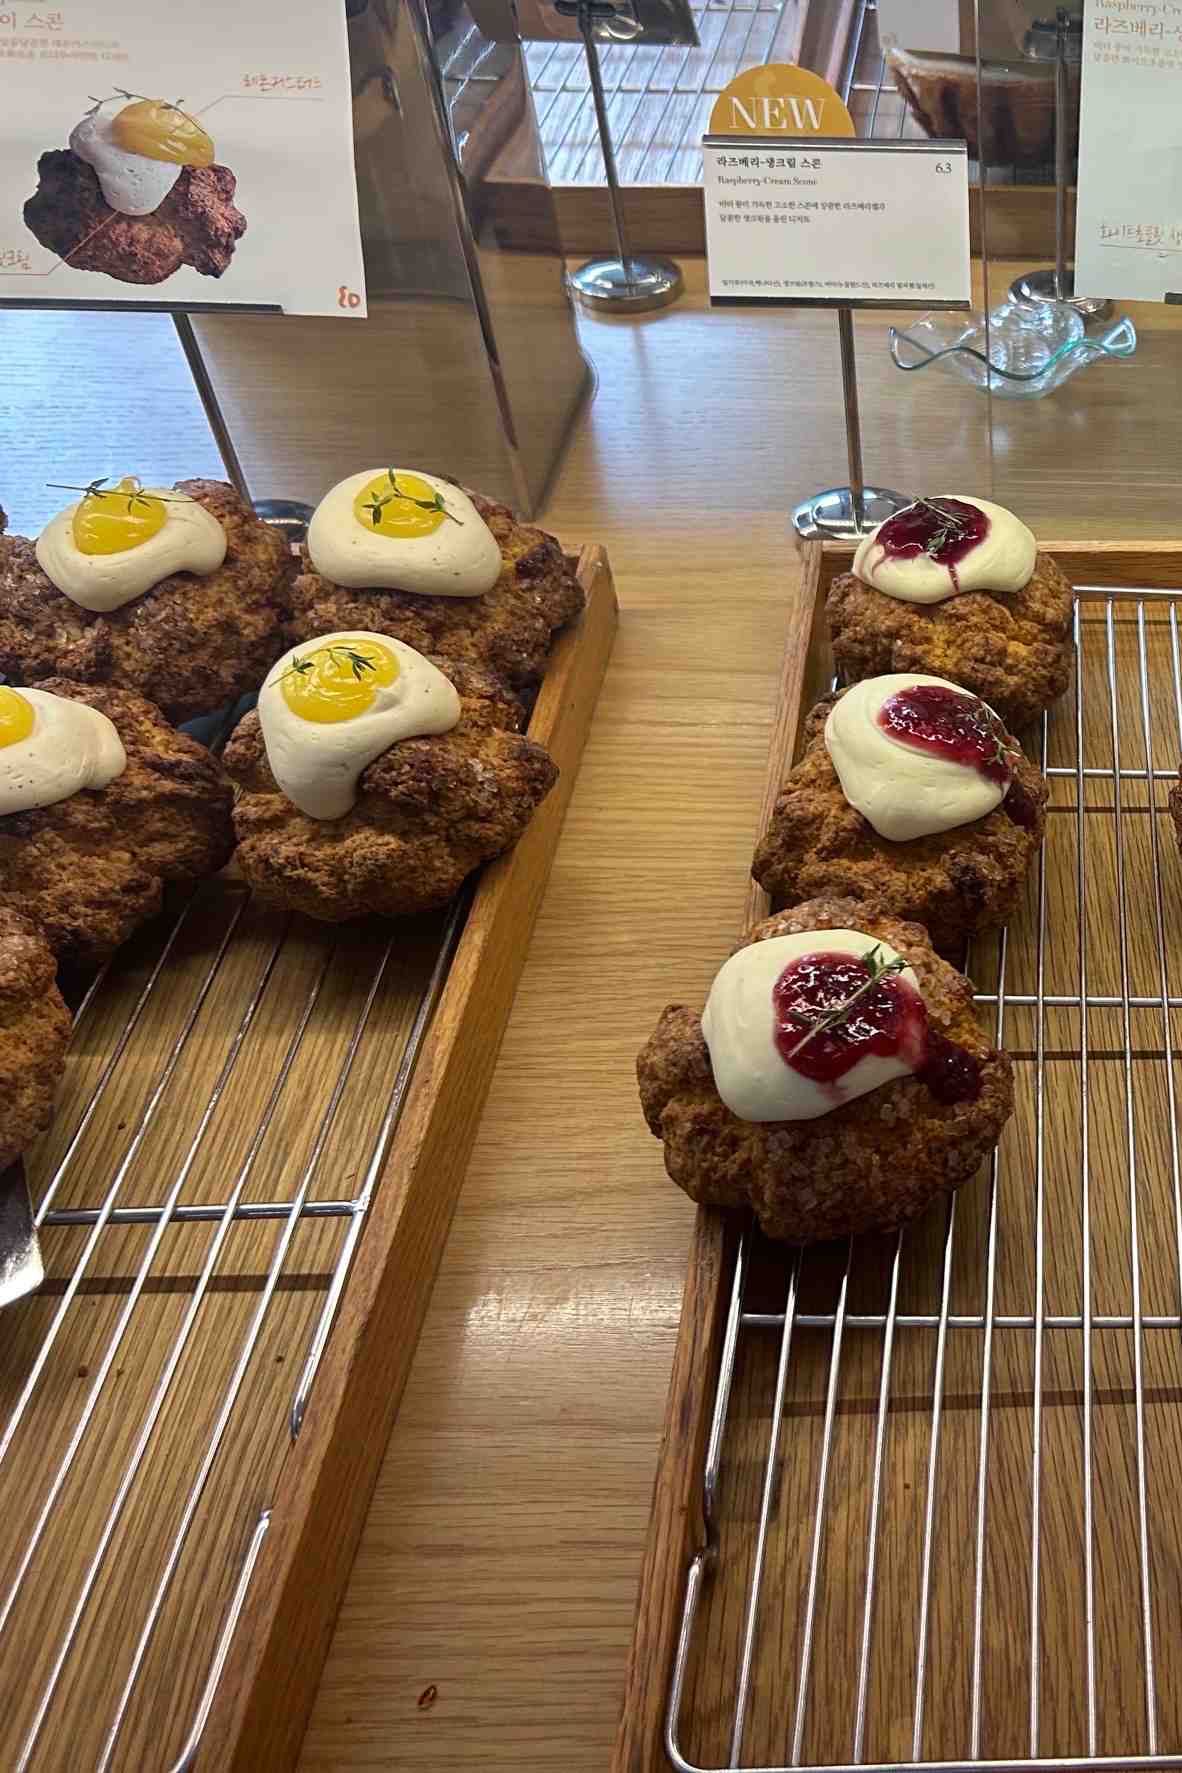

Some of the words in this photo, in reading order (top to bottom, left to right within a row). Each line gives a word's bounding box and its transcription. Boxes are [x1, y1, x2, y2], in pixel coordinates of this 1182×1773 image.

[24, 12, 64, 31] 스콘
[728, 96, 825, 130] NEW
[717, 156, 796, 169] 라즈베리-생크림
[800, 157, 822, 169] 스콘
[935, 162, 953, 175] 6.3
